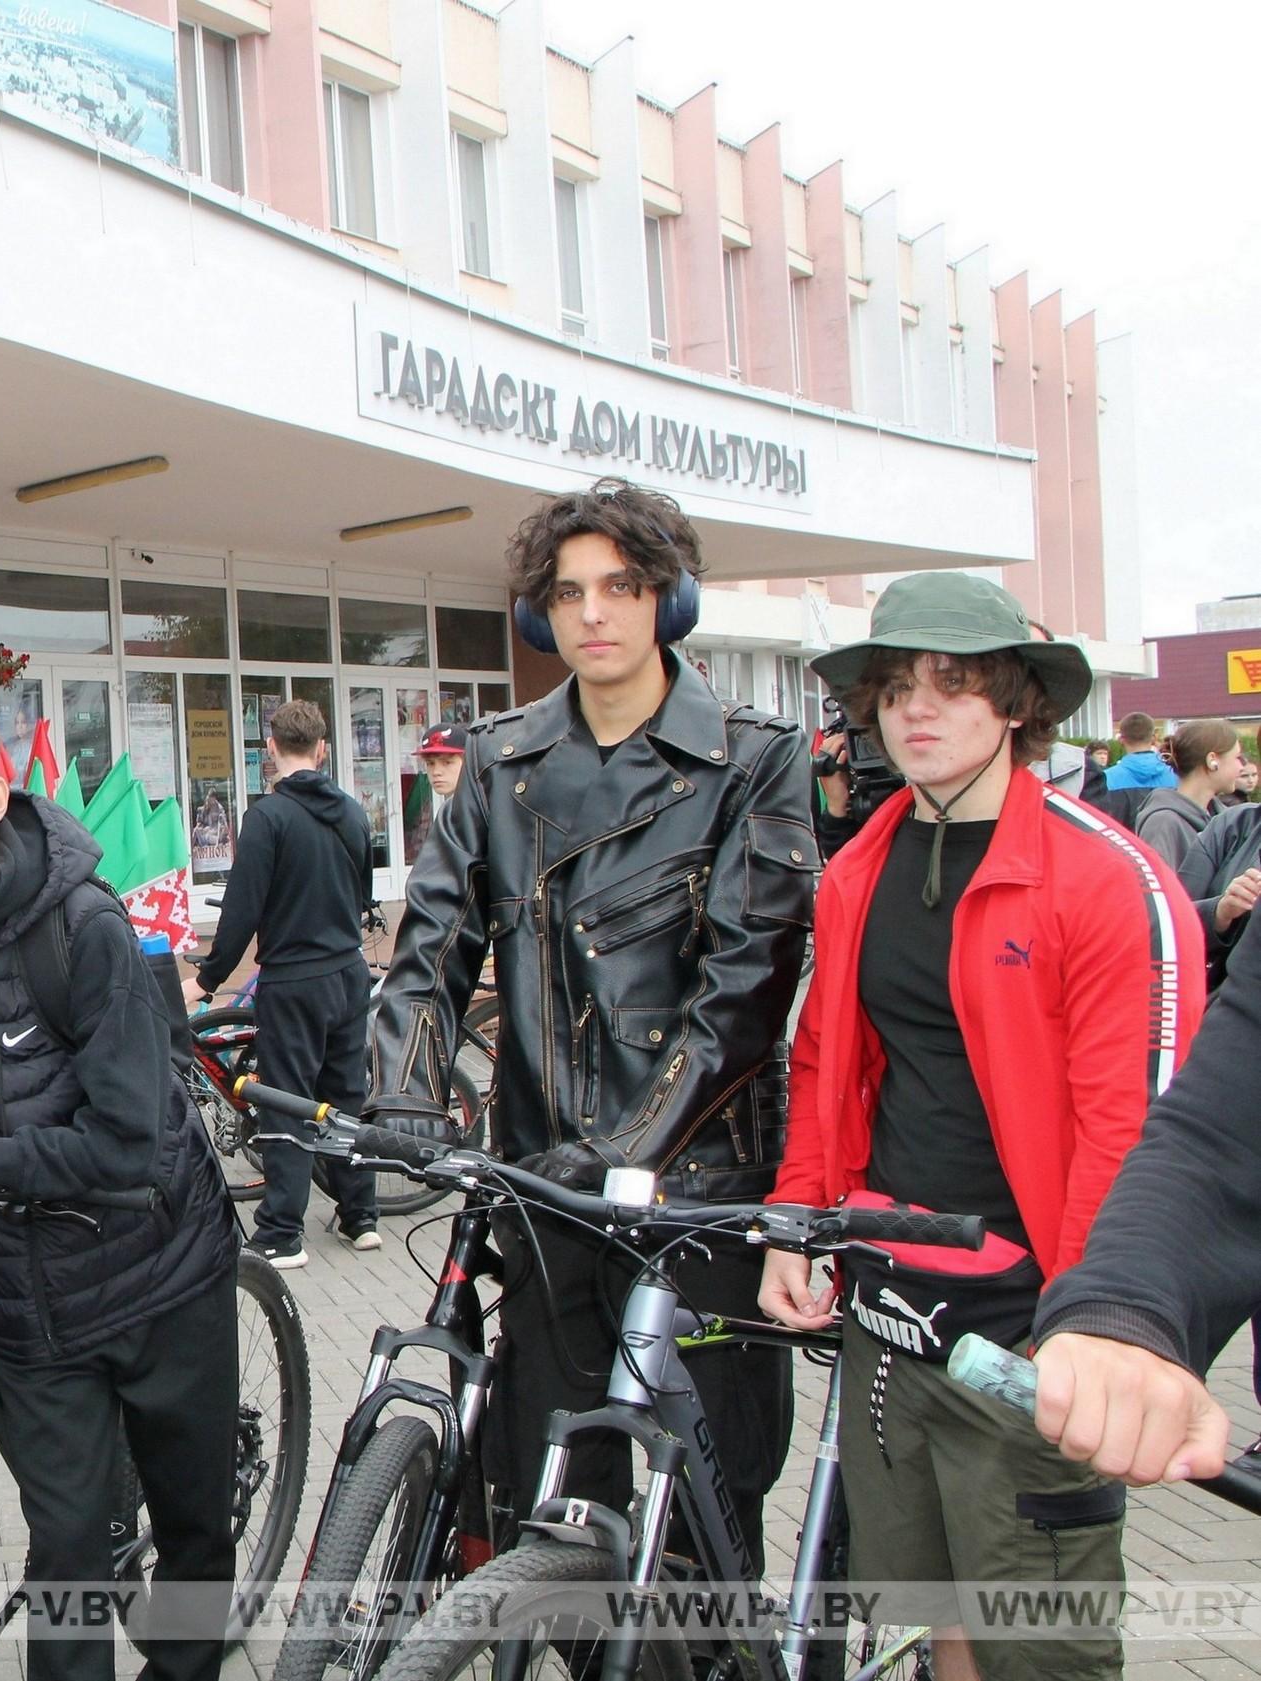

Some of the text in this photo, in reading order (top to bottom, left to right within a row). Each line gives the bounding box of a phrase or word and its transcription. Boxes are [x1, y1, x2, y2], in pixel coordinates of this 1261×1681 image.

[373, 331, 807, 494] ГАРАДСКІ ДОМ КУЛЬТУРЫ
